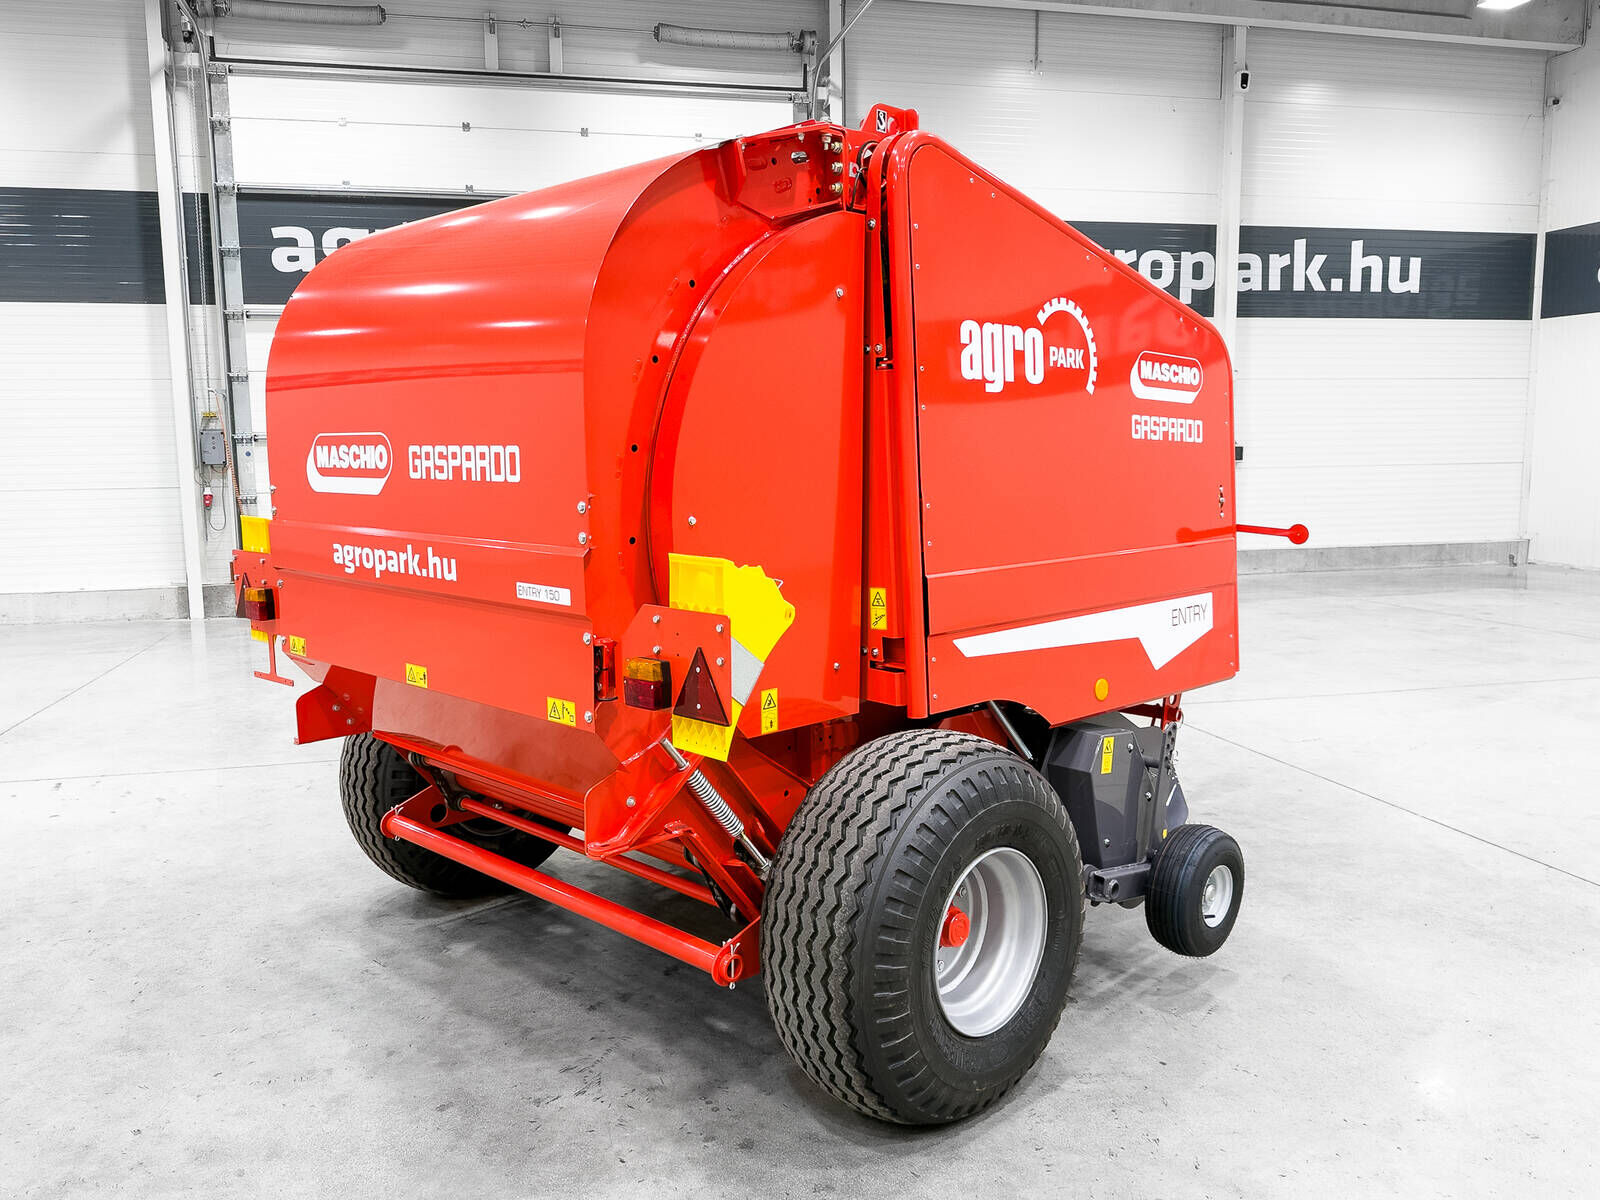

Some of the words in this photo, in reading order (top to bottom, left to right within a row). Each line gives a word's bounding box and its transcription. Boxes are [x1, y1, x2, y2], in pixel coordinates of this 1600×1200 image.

[960, 319, 1045, 393] agro
[1049, 346, 1085, 370] PARK
[1140, 360, 1201, 386] MASCHIO
[1131, 414, 1203, 443] GASPARDO
[316, 444, 388, 470] MASCHIO
[408, 445, 521, 483] GASPARDO
[332, 543, 457, 581] agropark.hu
[517, 584, 542, 599] ENTRY
[544, 589, 561, 602] 150
[1171, 602, 1208, 627] ENTRY
